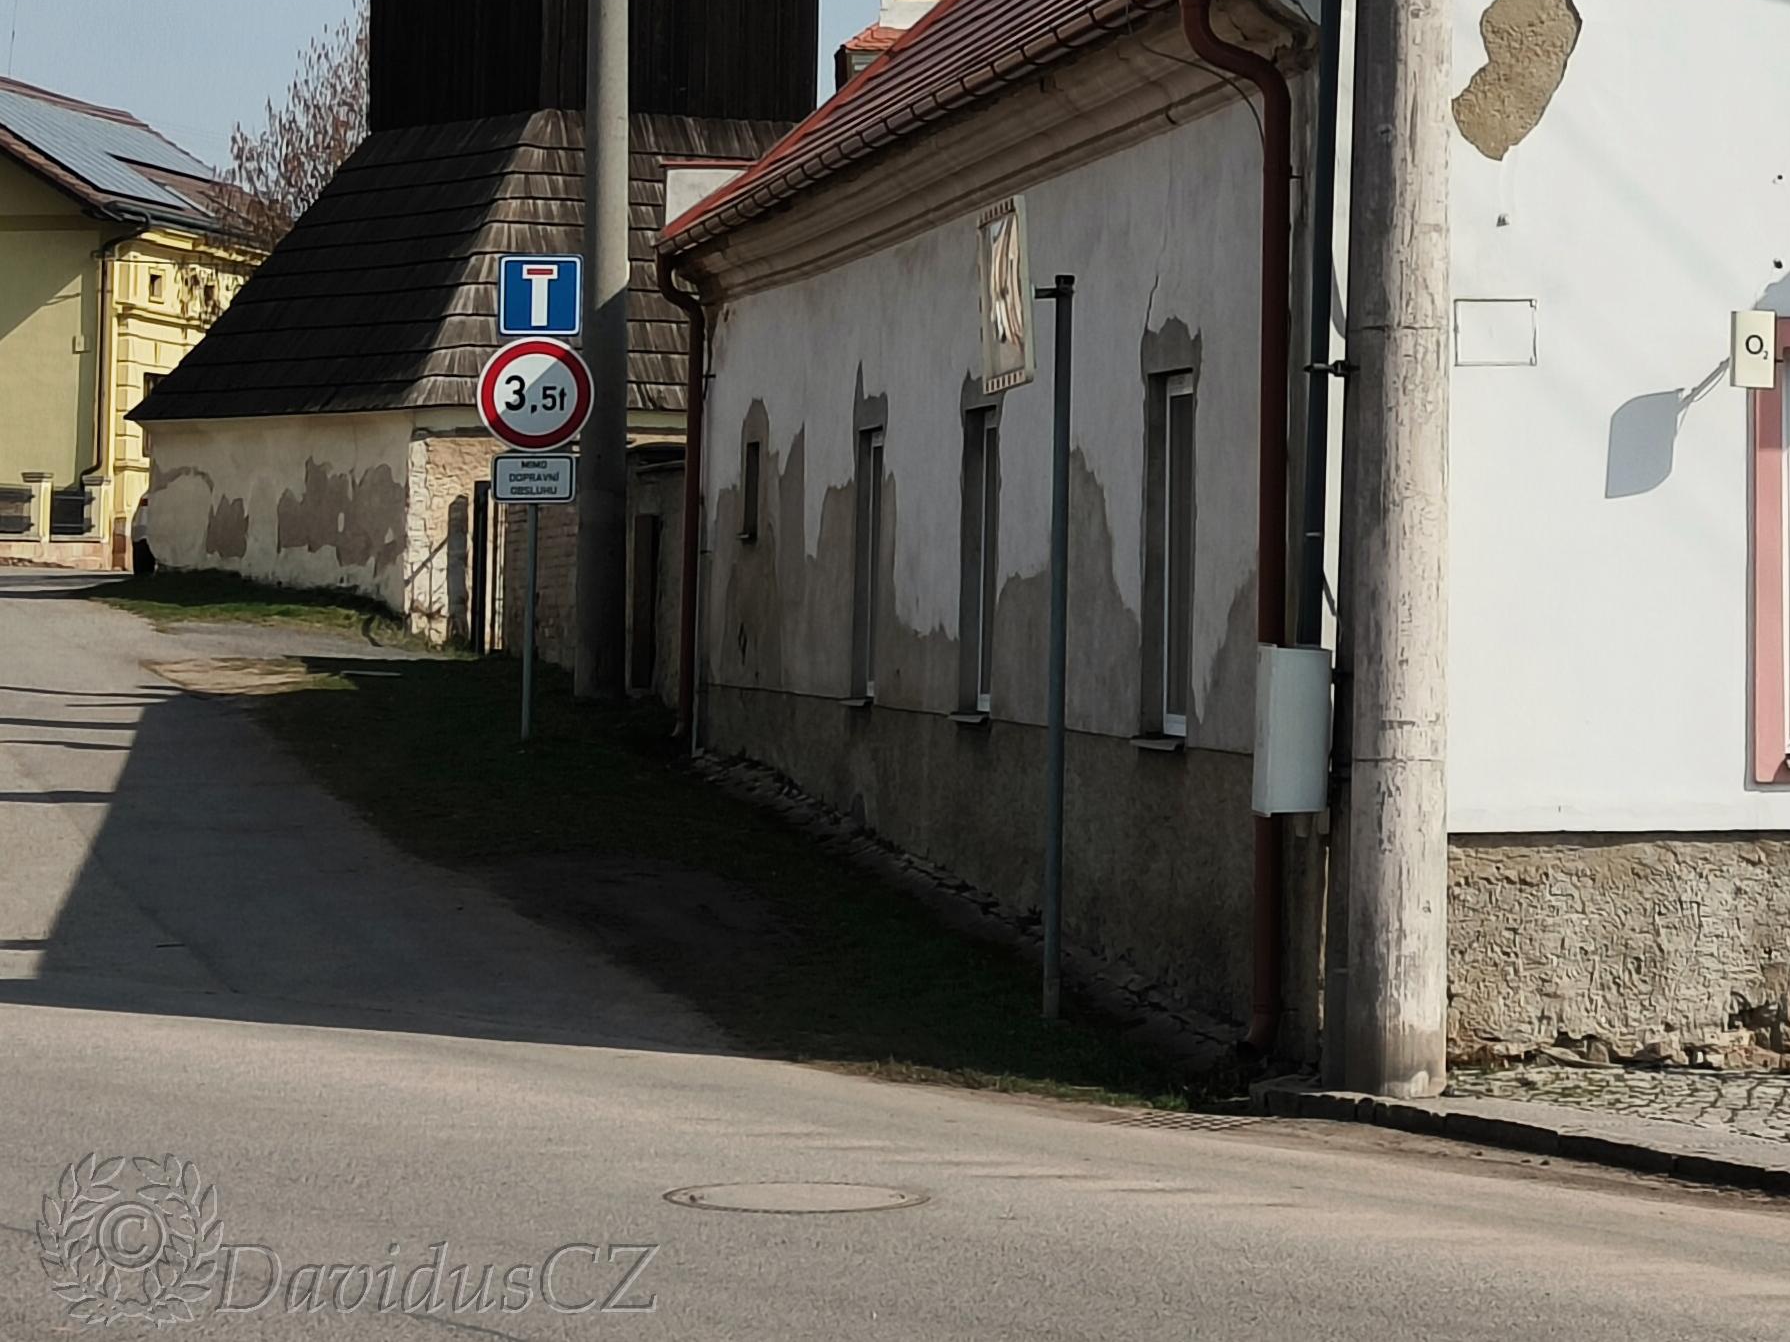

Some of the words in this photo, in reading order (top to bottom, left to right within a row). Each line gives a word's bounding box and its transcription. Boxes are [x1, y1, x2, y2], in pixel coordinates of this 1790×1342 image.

[505, 375, 567, 415] 3,5t
[521, 460, 548, 469] MIMO
[509, 472, 559, 482] DOPRAVNÍ
